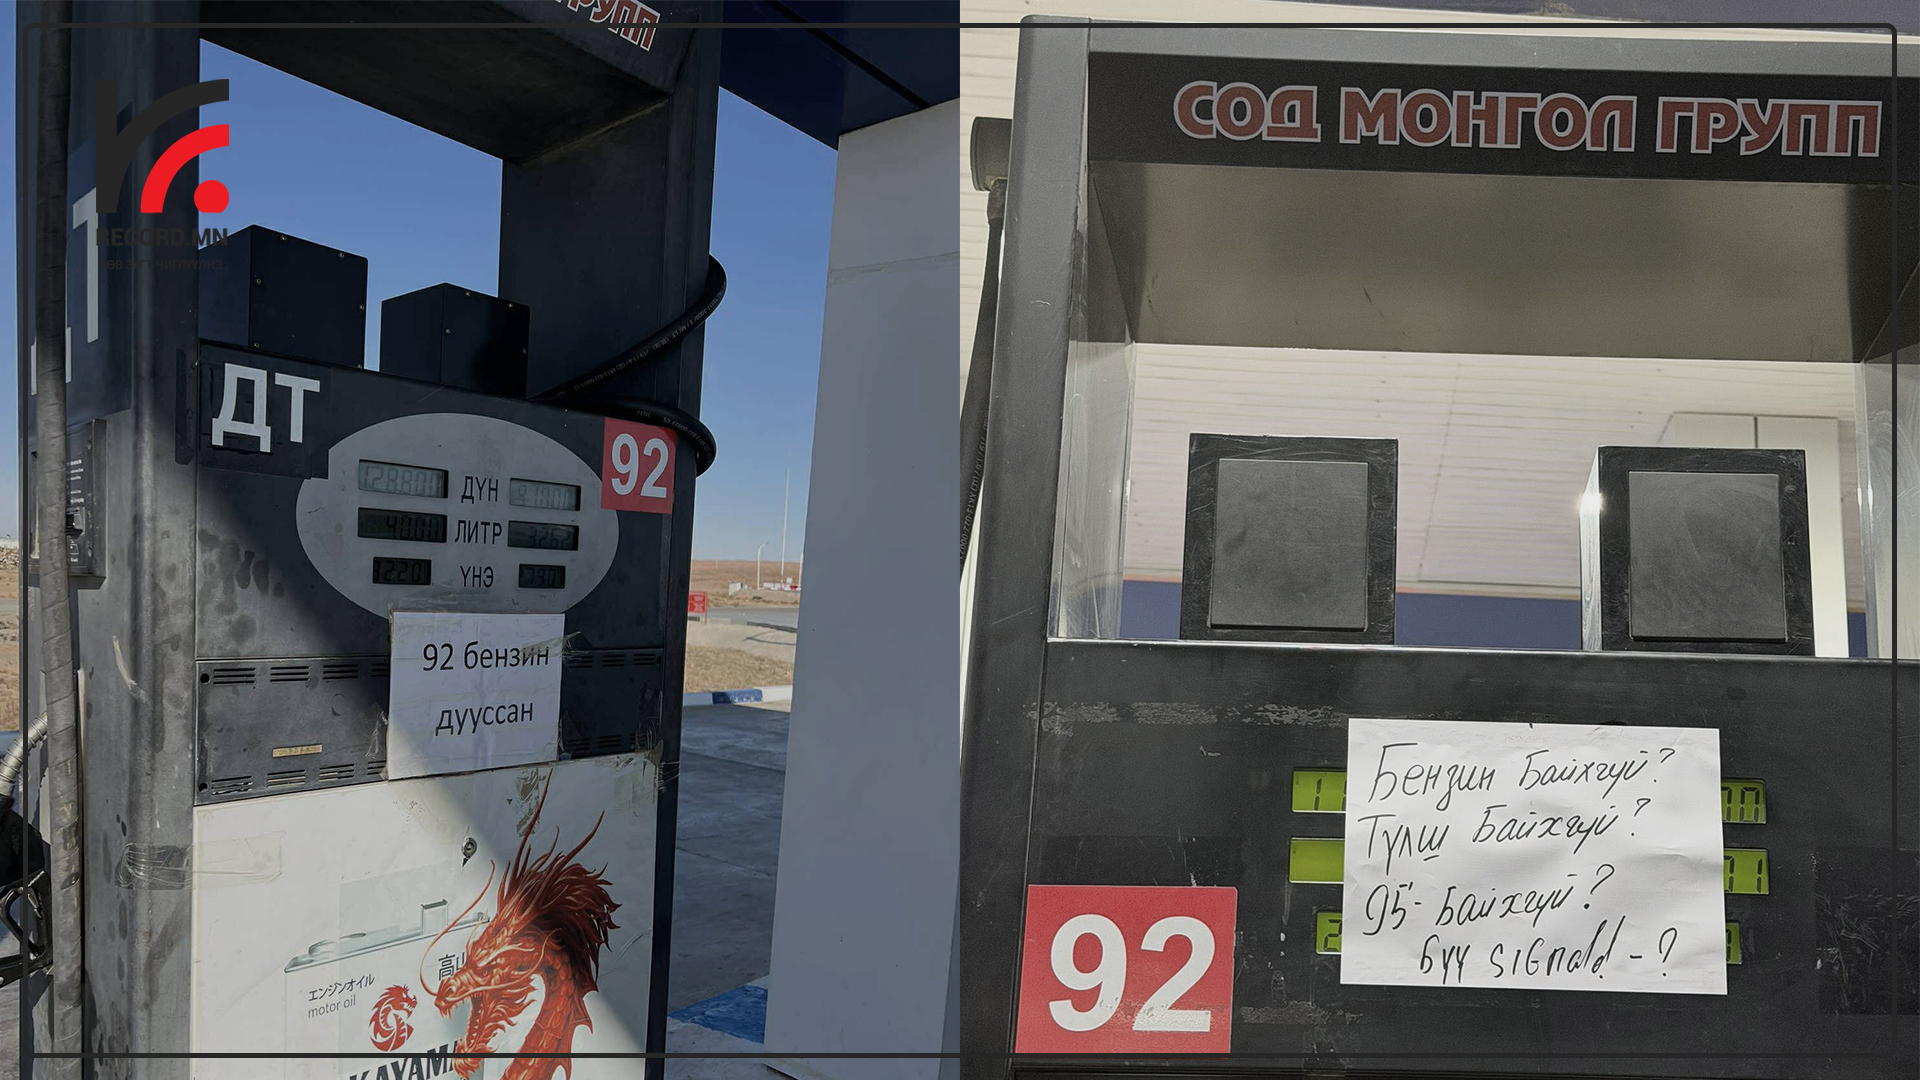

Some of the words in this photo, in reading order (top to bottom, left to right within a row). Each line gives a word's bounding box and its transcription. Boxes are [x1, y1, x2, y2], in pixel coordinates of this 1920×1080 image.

[1174, 80, 1321, 143] СОД
[1338, 86, 1635, 152] МОНГОЛ
[1655, 95, 1882, 158] ГРУПП
[211, 362, 321, 452] ДТ
[610, 432, 669, 499] 92
[460, 475, 499, 504] ДҮН
[454, 519, 503, 545] ЛИТР
[460, 565, 494, 589] ҮНЭ
[423, 643, 454, 671] 92
[464, 641, 549, 669] бензин
[435, 702, 533, 737] дууссан
[1368, 742, 1496, 811] Бензин
[308, 973, 376, 1002] エンジンオイル
[1048, 913, 1216, 1034] 92
[308, 1000, 340, 1019] motor
[343, 994, 356, 1009] oil
